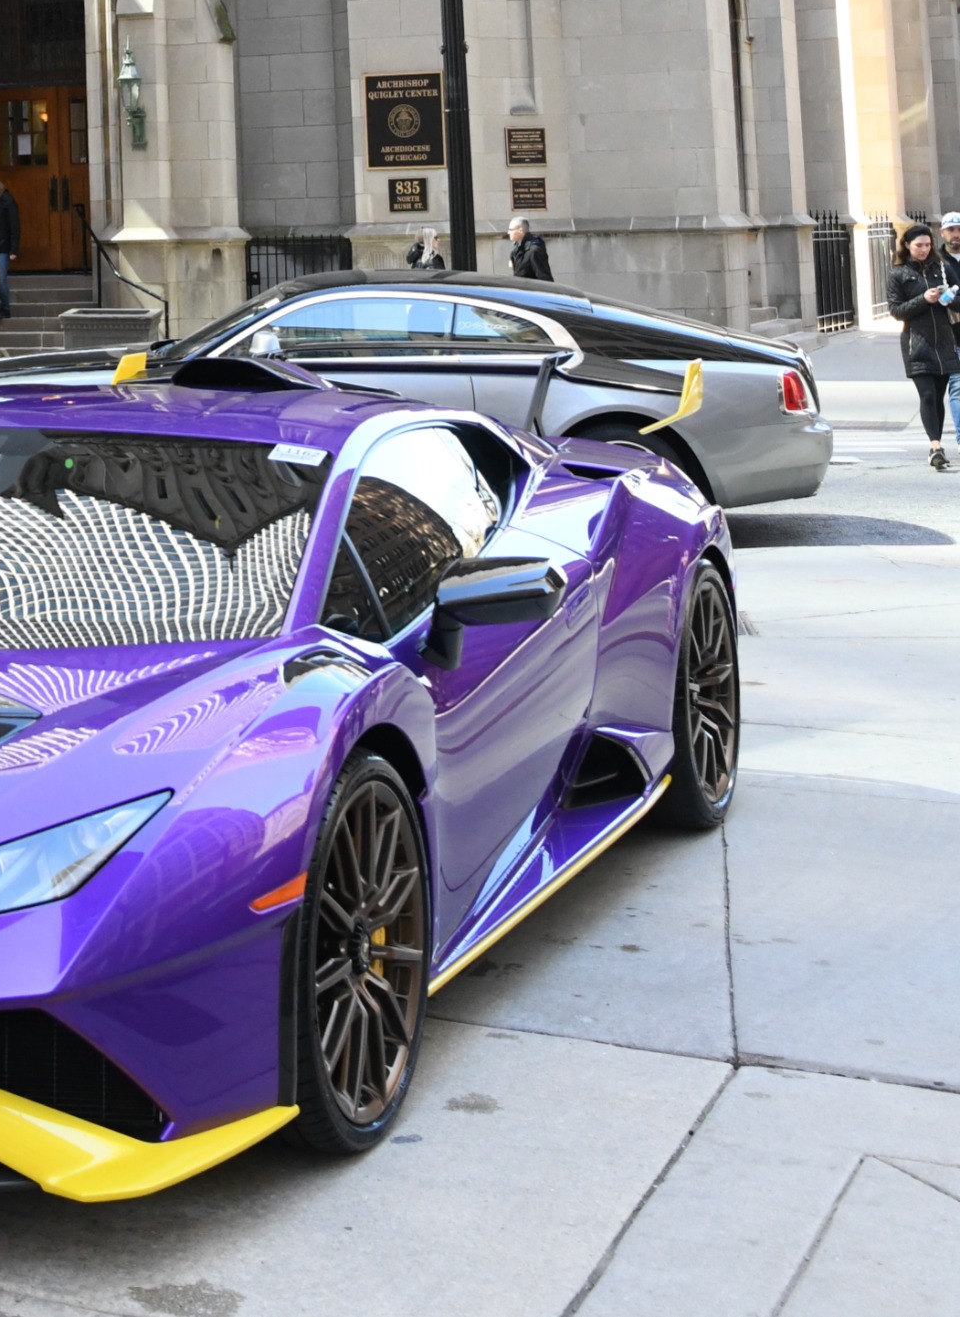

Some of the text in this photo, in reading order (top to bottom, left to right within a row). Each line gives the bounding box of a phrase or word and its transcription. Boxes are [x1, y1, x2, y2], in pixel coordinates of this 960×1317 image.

[376, 79, 429, 89] ARCHBISHOP
[368, 89, 438, 100] QUIGLEY CENTER
[381, 145, 431, 153] ARCHDIOCESE
[395, 153, 428, 161] CHICAGO
[395, 181, 420, 194] 835
